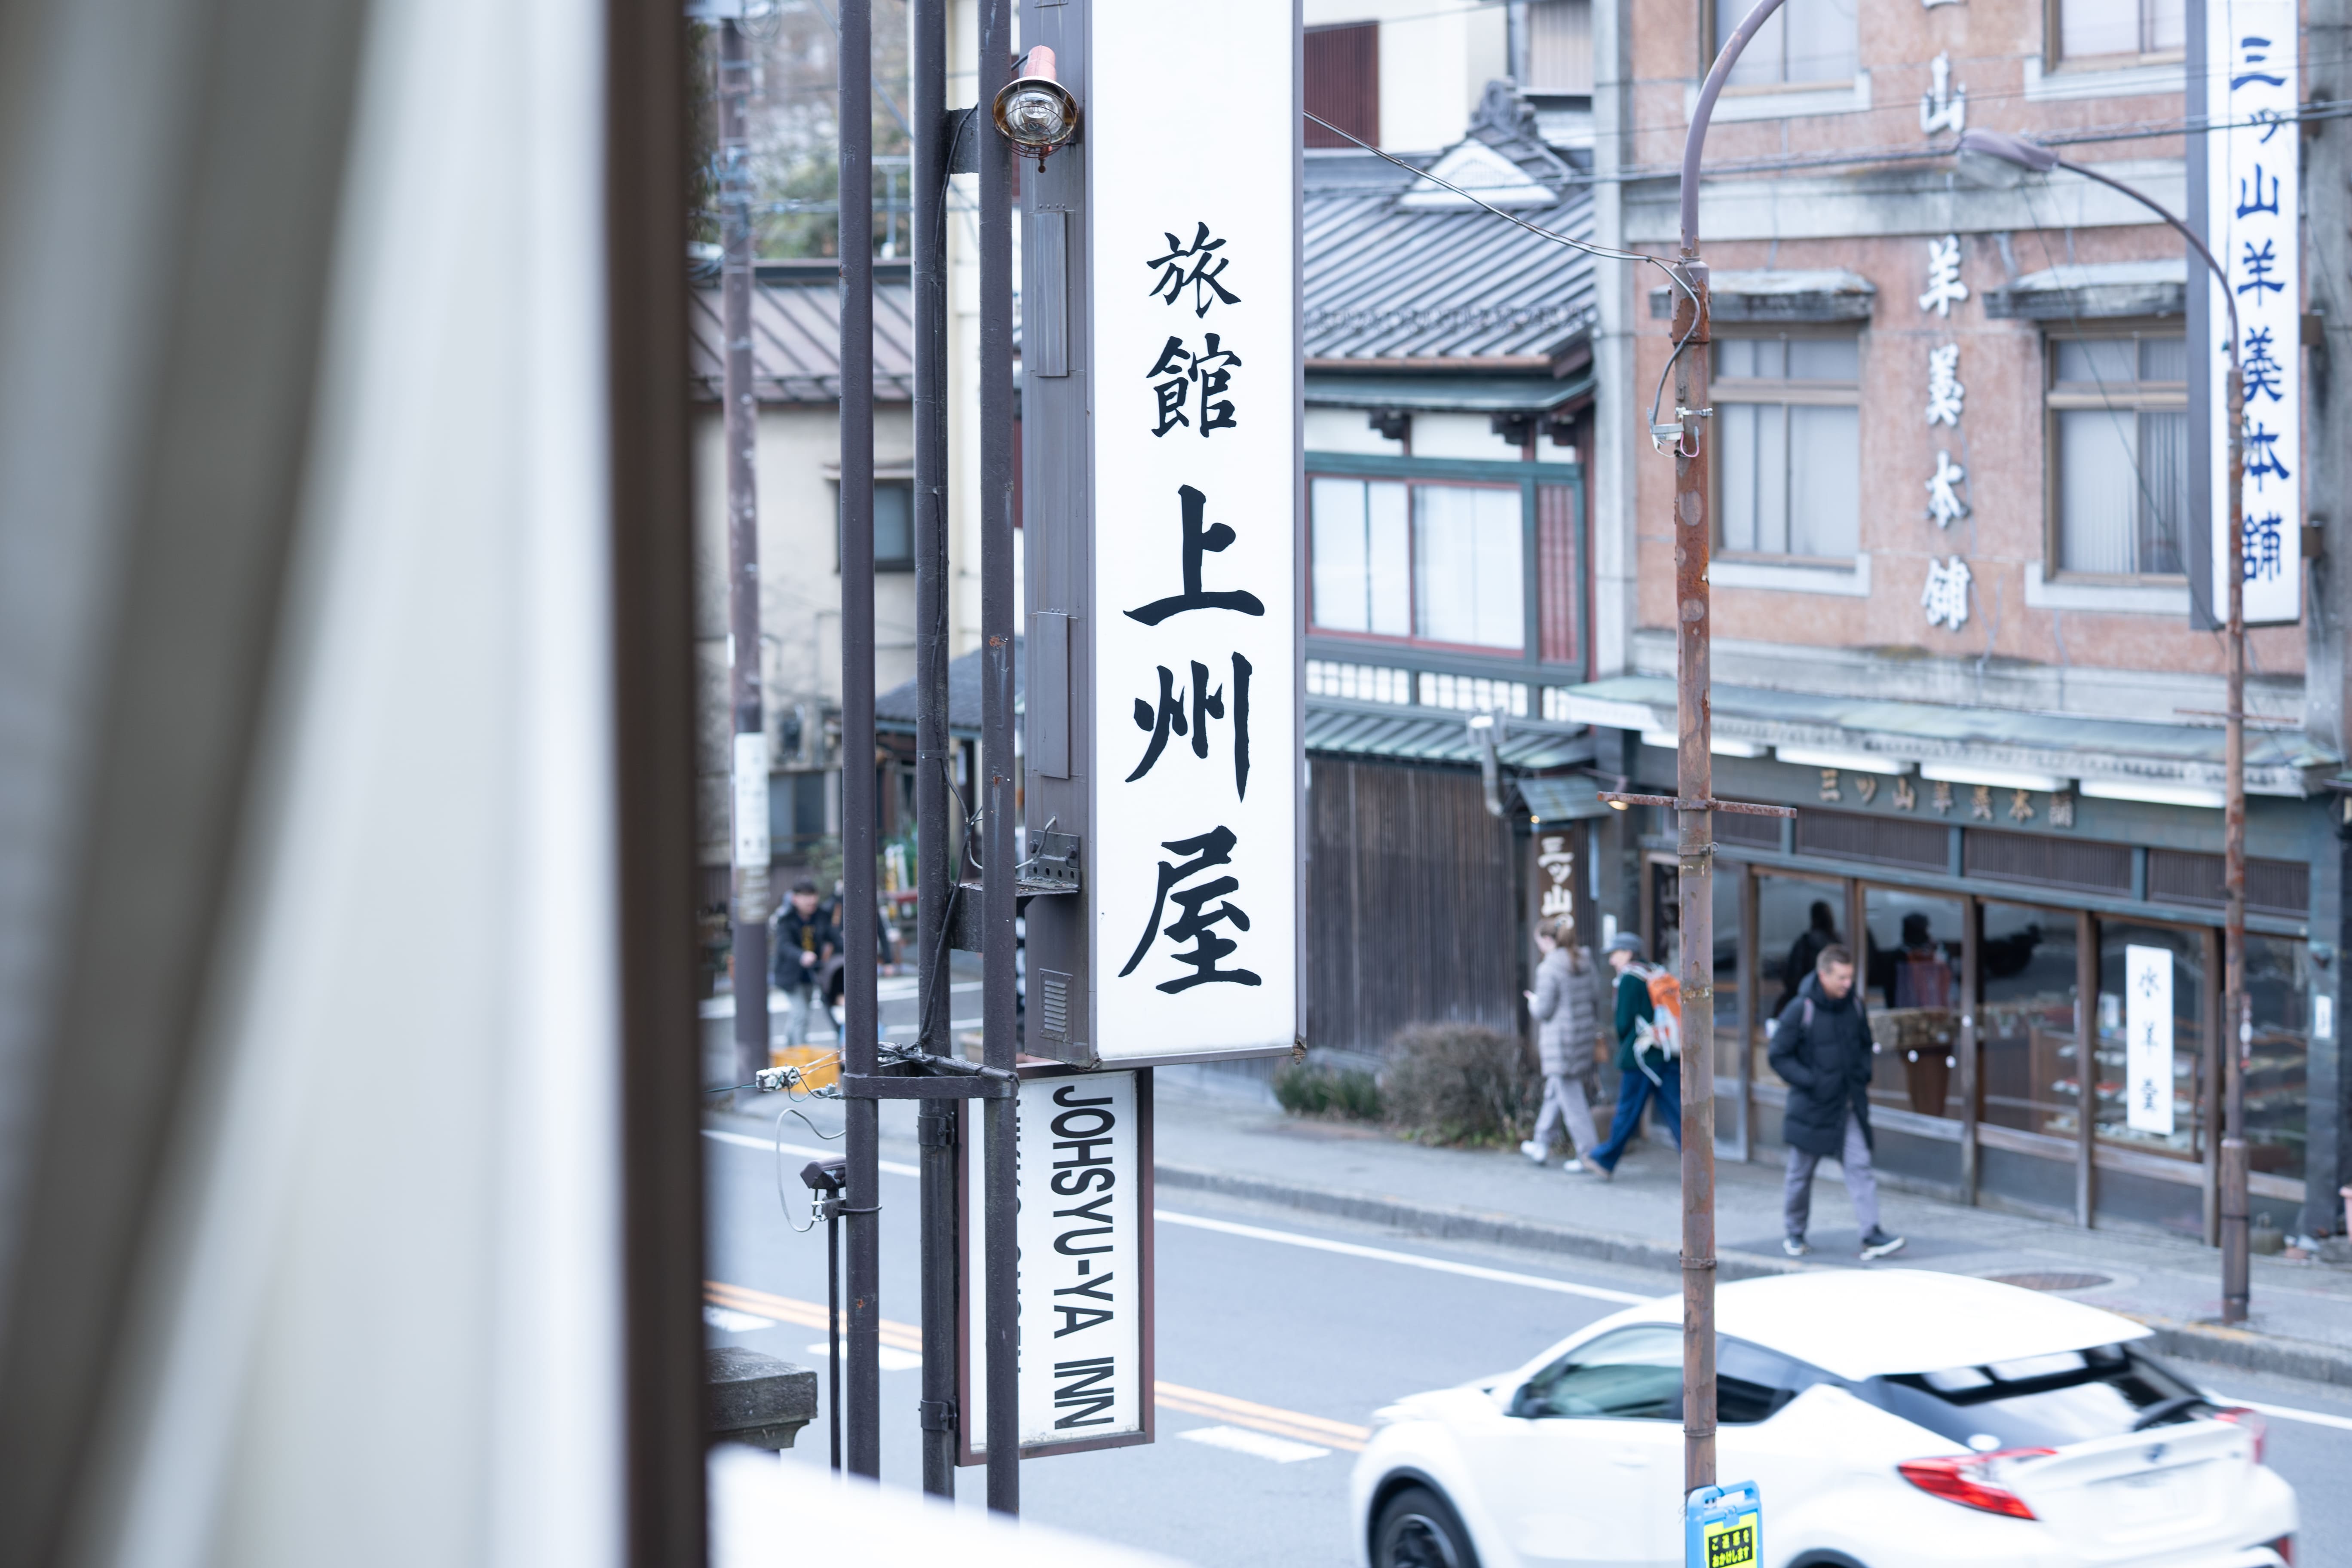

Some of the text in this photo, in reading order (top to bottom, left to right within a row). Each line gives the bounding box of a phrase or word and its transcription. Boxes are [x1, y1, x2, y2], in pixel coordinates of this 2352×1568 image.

[1118, 221, 1265, 994] 旅館 上州屋
[1050, 1085, 1115, 1430] JOHSYU-YA INN
